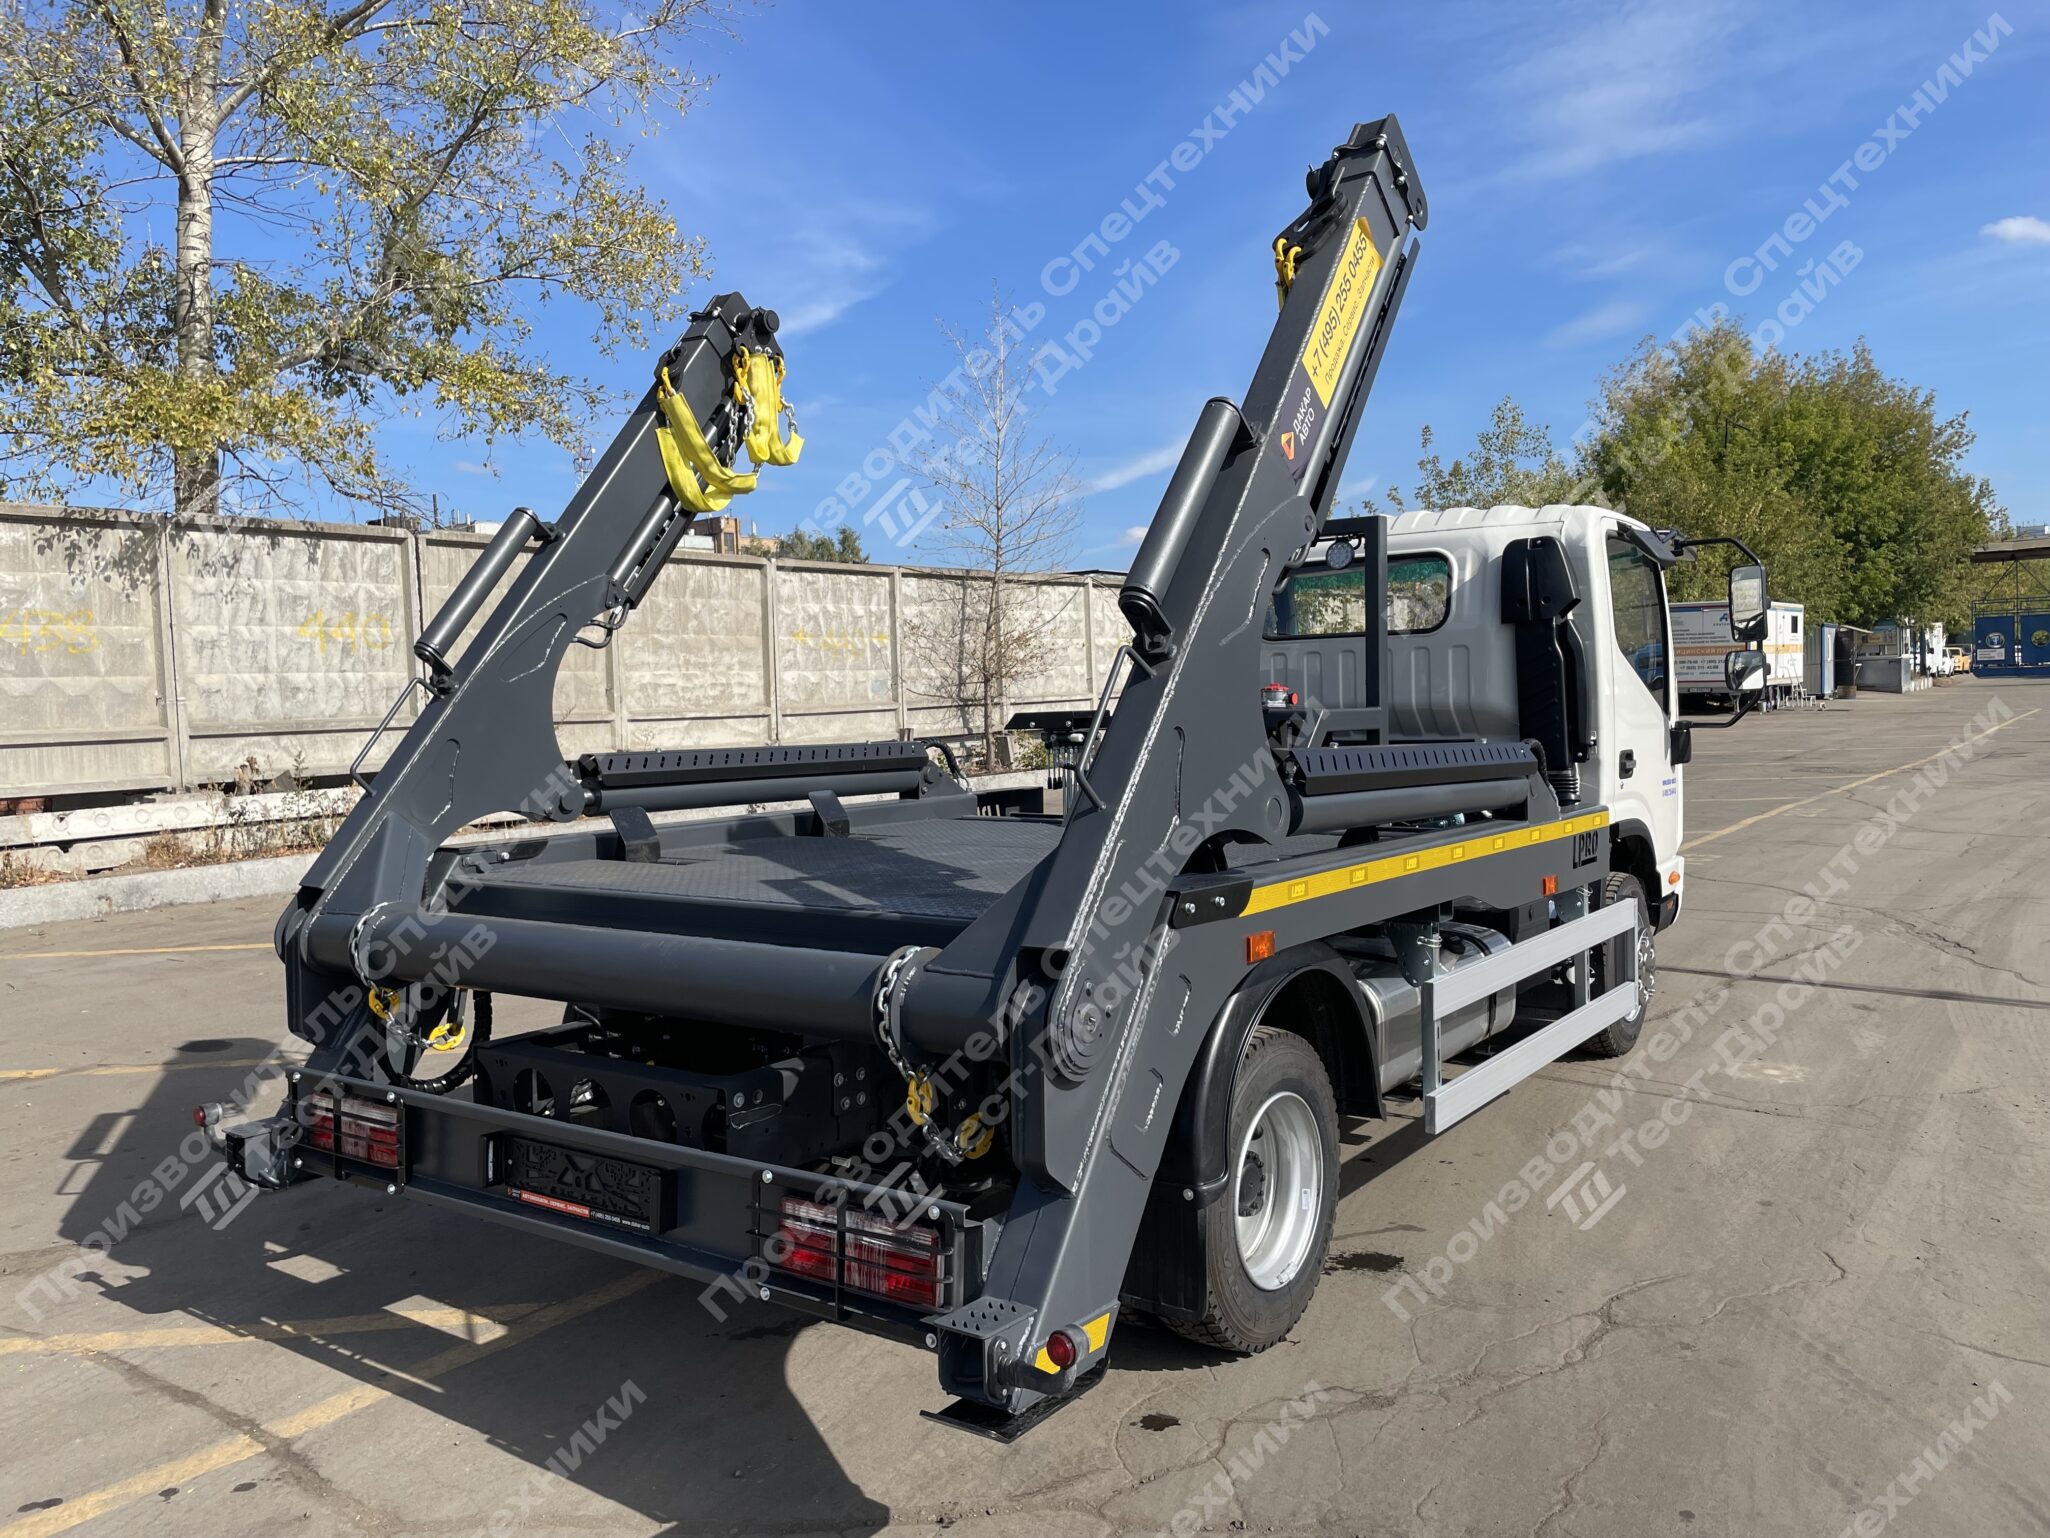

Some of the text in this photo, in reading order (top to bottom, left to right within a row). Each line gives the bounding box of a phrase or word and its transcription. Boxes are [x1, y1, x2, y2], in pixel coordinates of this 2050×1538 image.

[1318, 305, 1341, 358] (495)
[1335, 272, 1352, 315] 255
[1348, 232, 1367, 279] 0455
[1292, 386, 1312, 436] ДАКАР
[1299, 407, 1315, 446] АВТО
[297, 607, 391, 655] 440
[1676, 646, 1717, 656] ИЦИНСКИЙ
